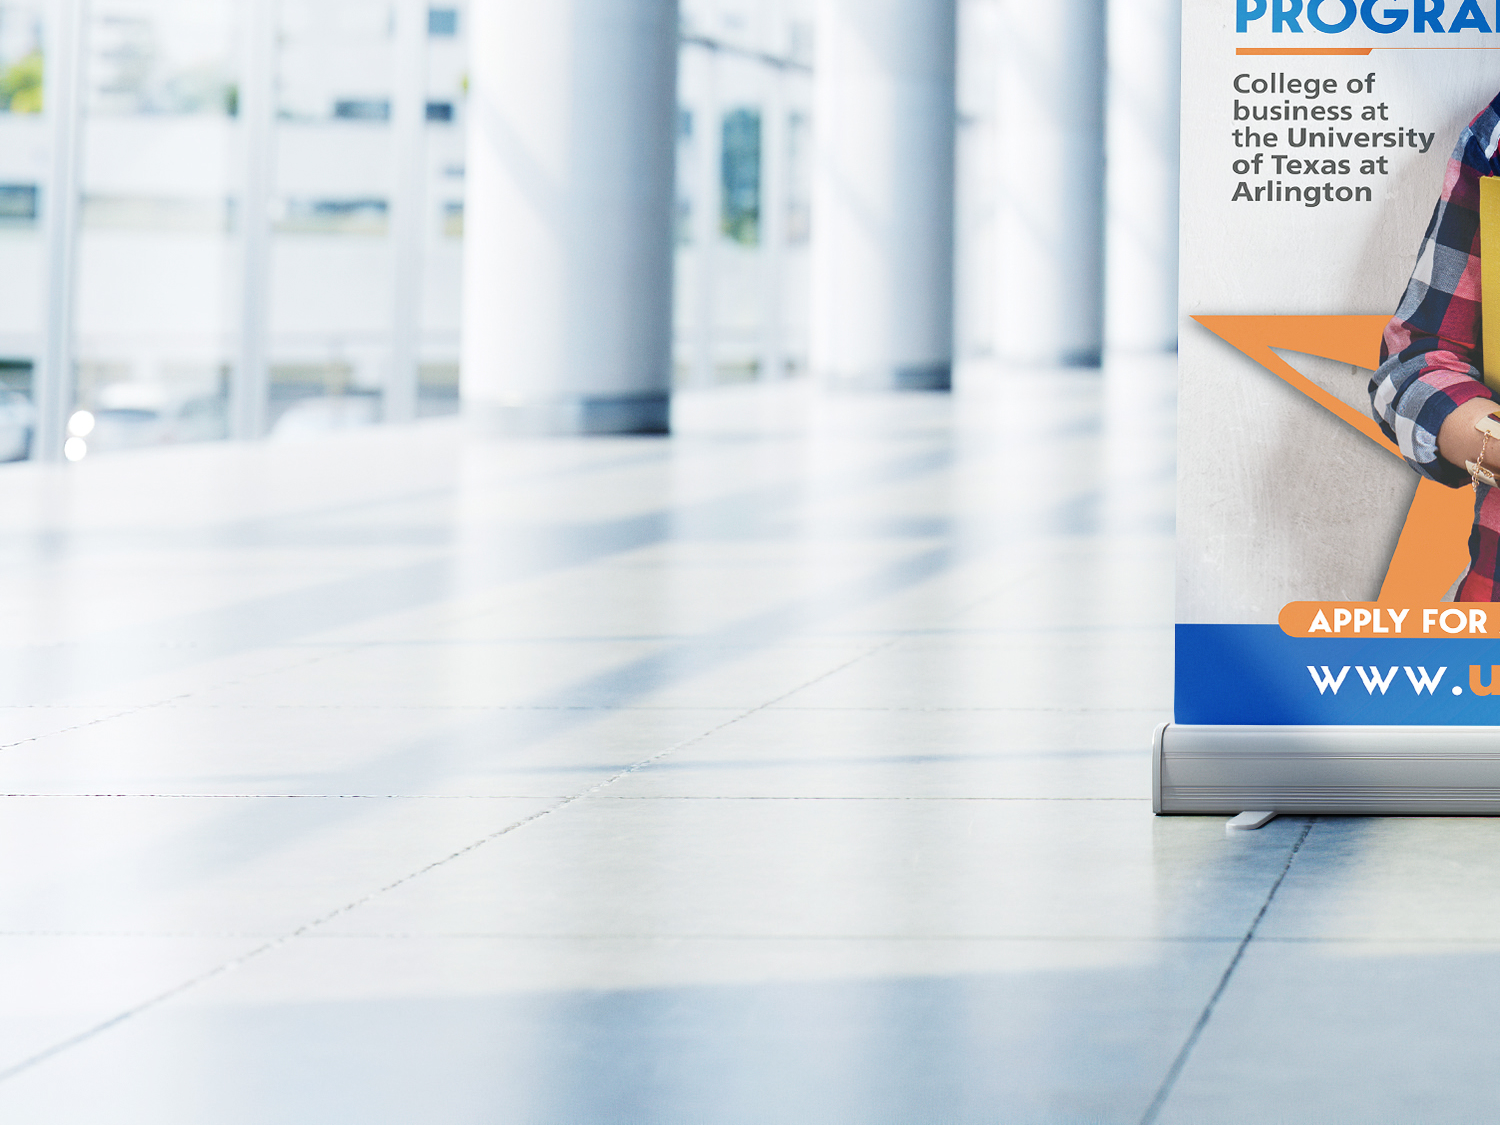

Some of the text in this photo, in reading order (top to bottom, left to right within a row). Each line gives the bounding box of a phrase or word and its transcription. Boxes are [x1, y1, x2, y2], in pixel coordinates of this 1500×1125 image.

[1233, 73, 1376, 99] College of
[1233, 101, 1389, 122] business at
[1232, 126, 1436, 154] the University
[1232, 154, 1389, 175] of Texas at
[1231, 181, 1373, 207] Arlington
[1308, 608, 1409, 635] APPLY
[1422, 608, 1487, 635] FOR
